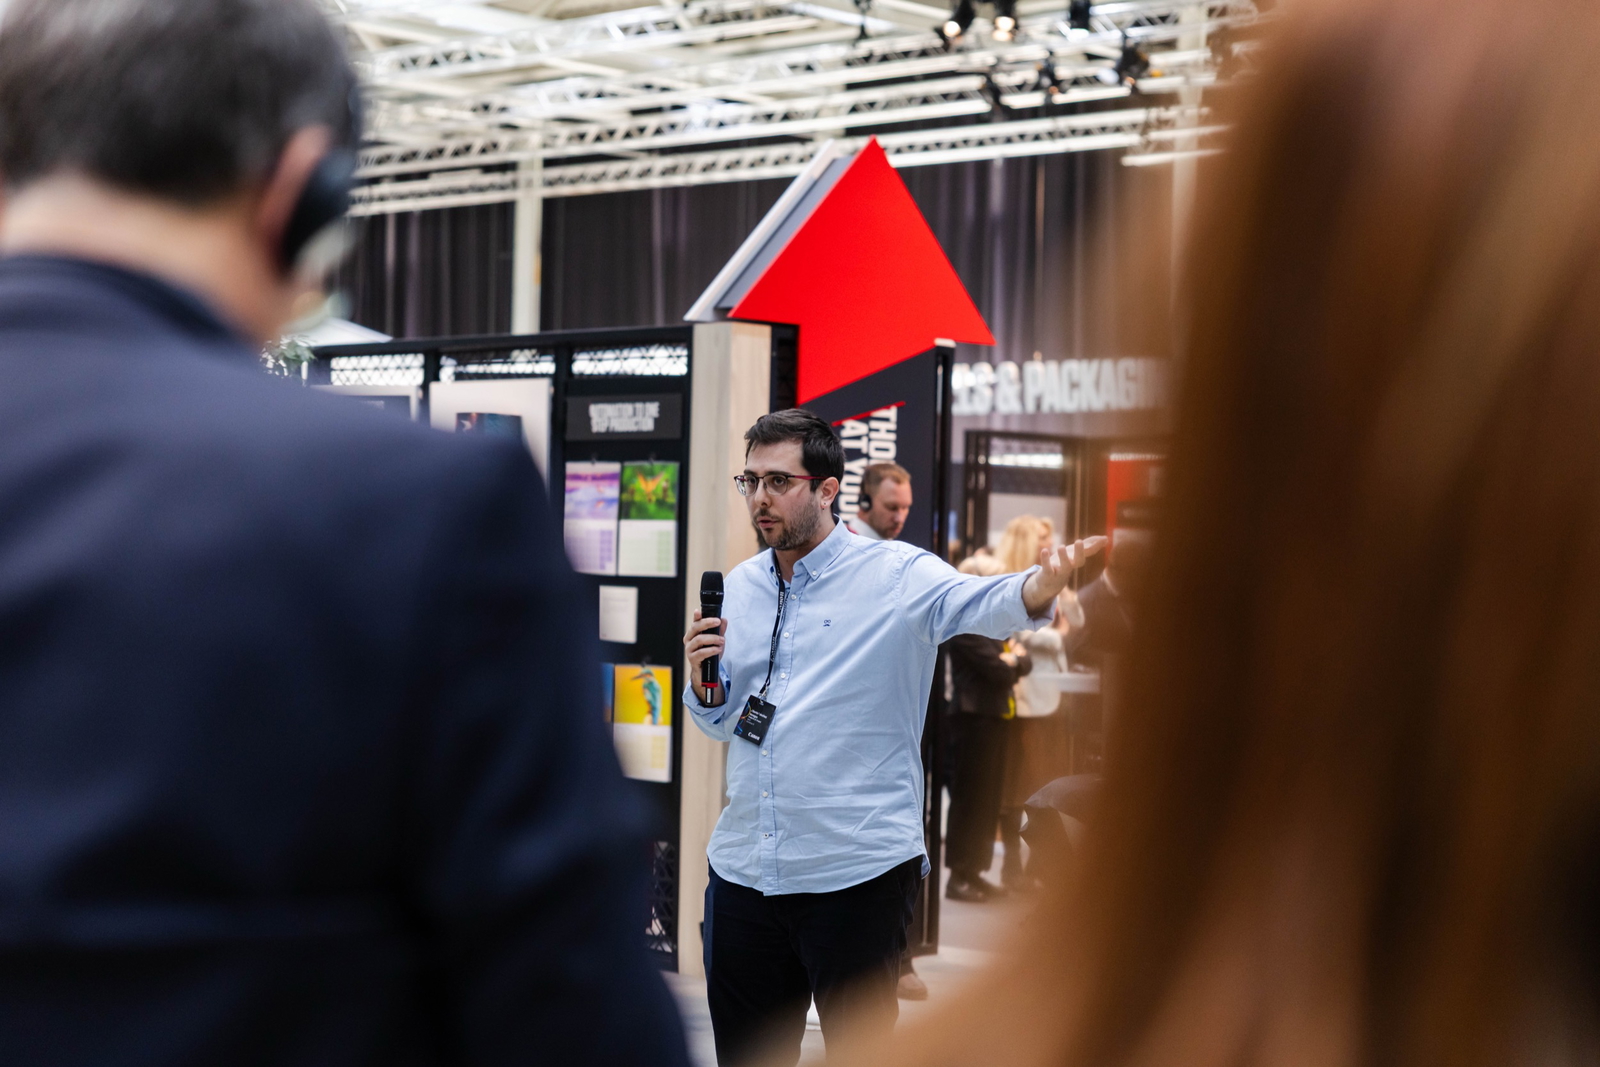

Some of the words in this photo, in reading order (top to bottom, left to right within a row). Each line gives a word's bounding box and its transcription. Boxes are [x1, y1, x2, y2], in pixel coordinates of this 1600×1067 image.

[996, 361, 1023, 415] &
[840, 419, 869, 453] AT
[868, 405, 898, 465] THO
